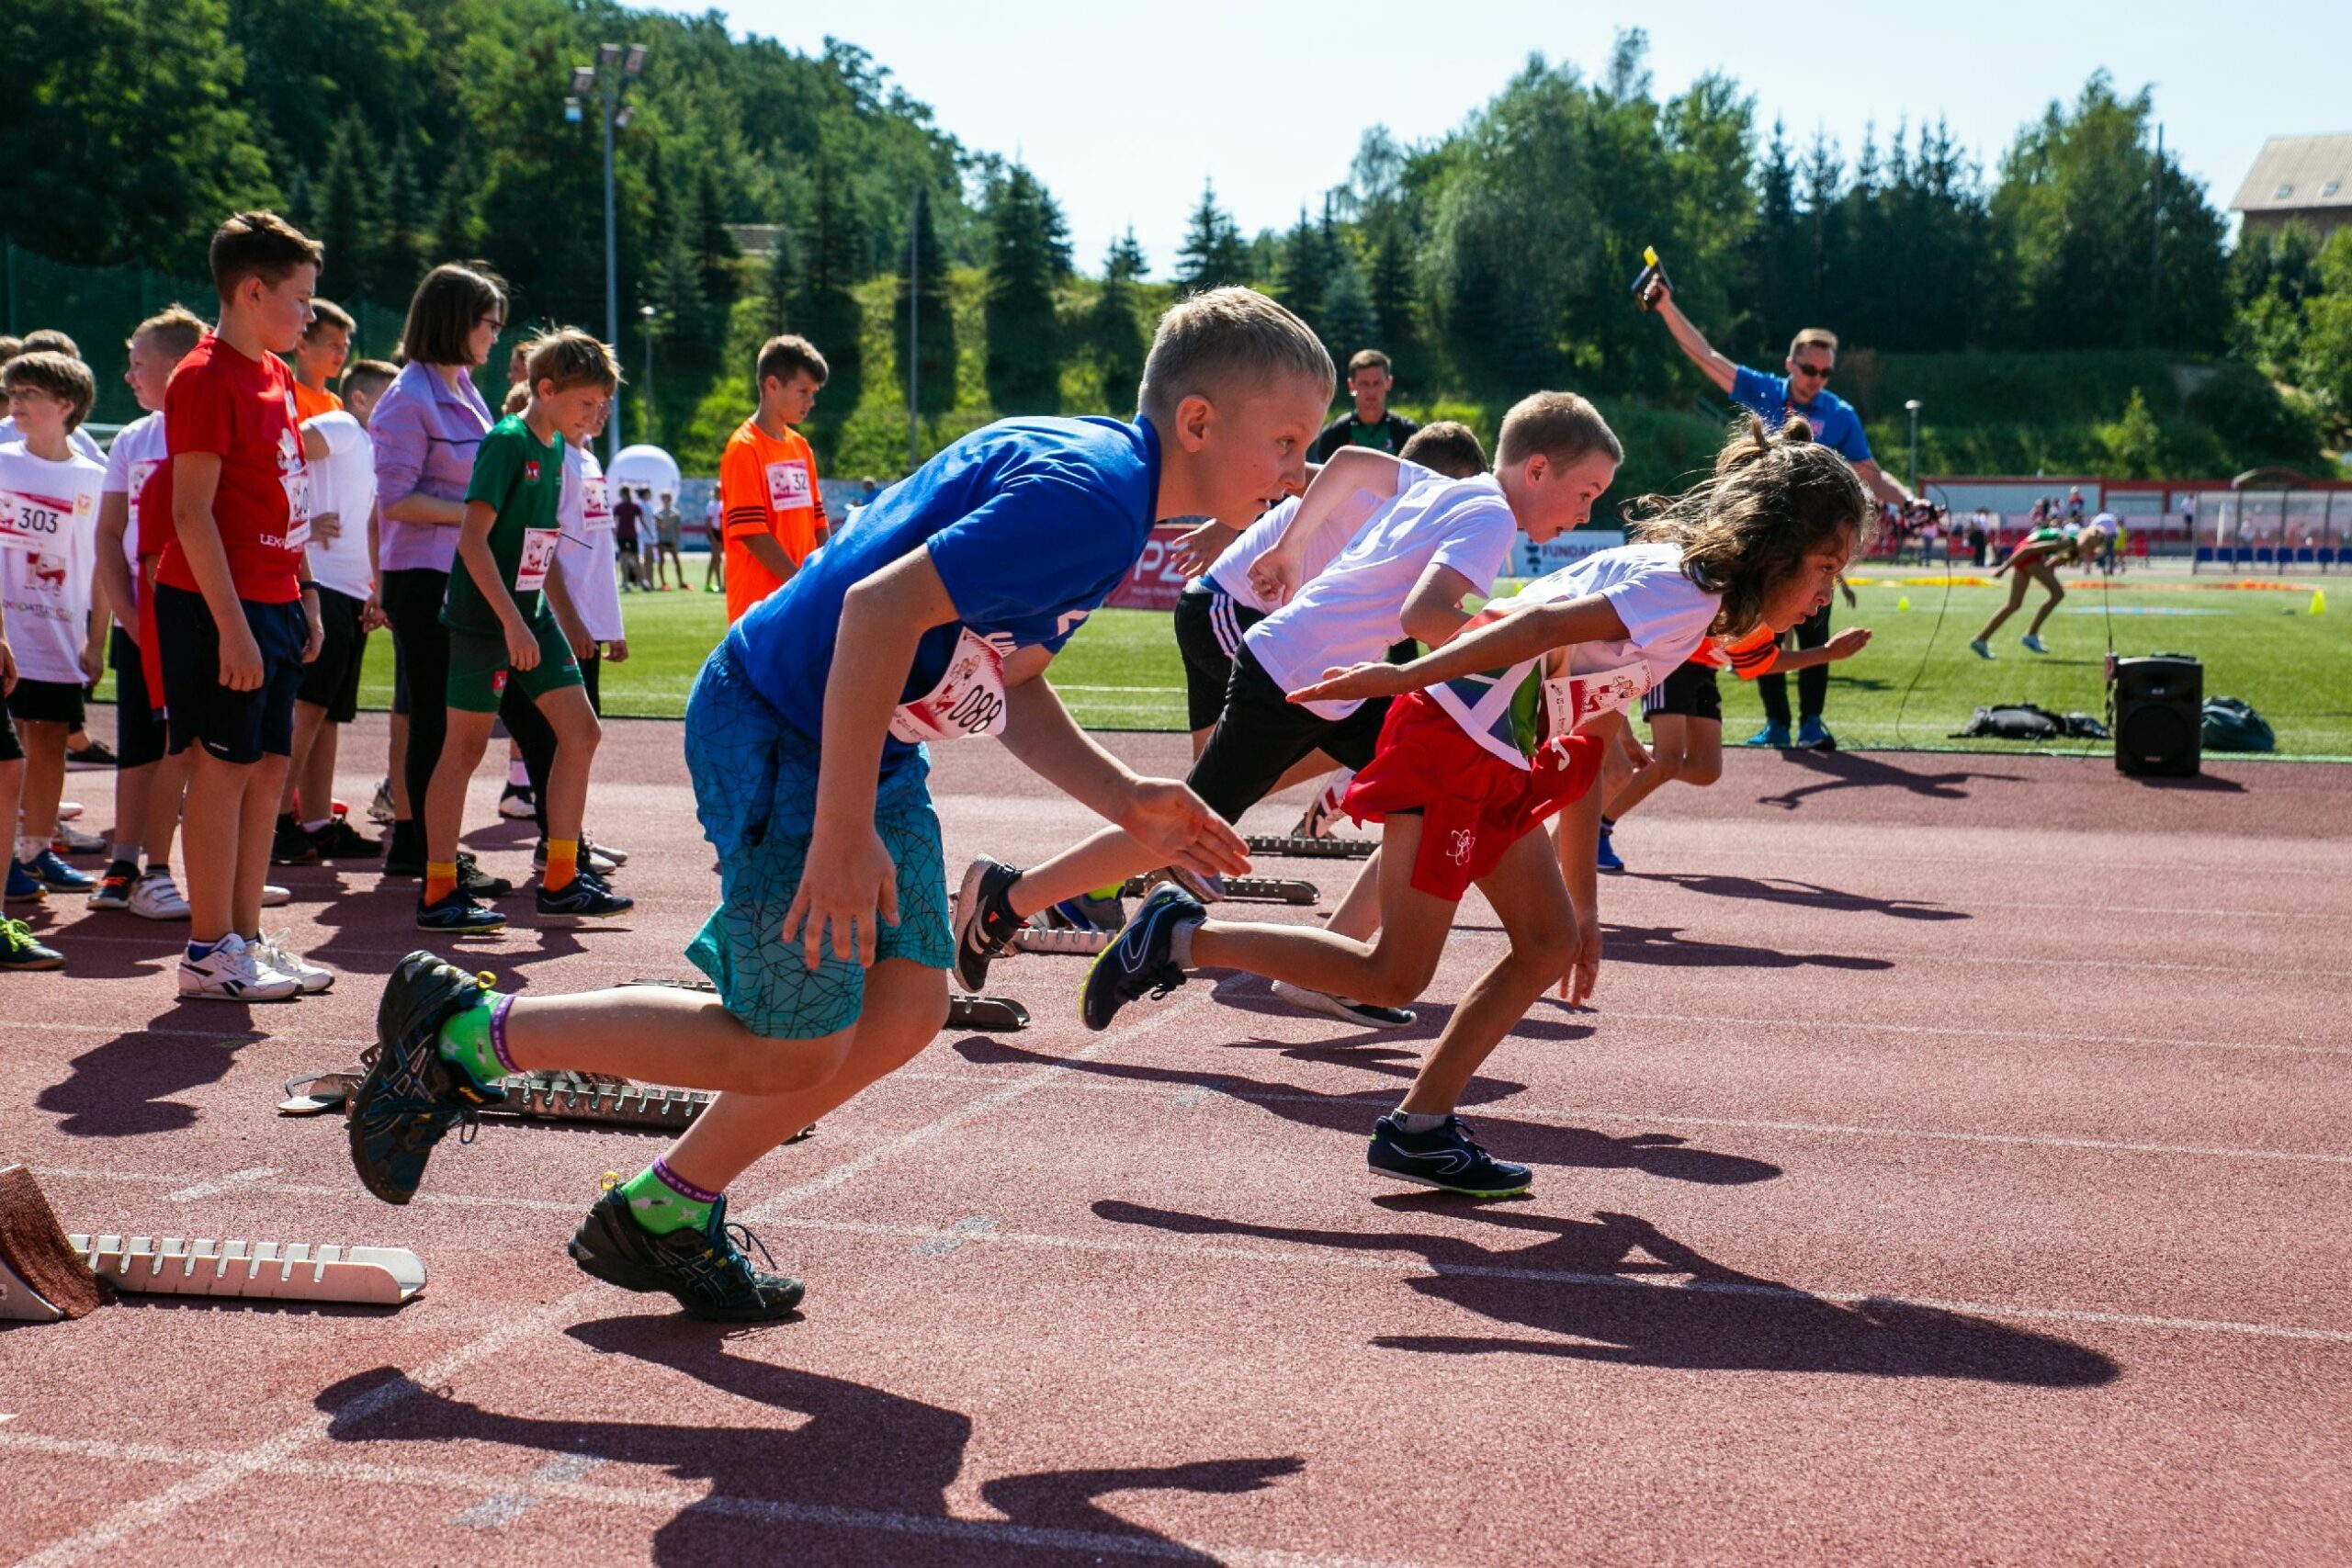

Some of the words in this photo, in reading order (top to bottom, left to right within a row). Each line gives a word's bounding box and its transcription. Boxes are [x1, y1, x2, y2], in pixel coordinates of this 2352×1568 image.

[18, 507, 58, 534] 303
[1134, 540, 1196, 581] PZ
[1542, 545, 1610, 558] FUNDAC
[948, 684, 1002, 734] 088
